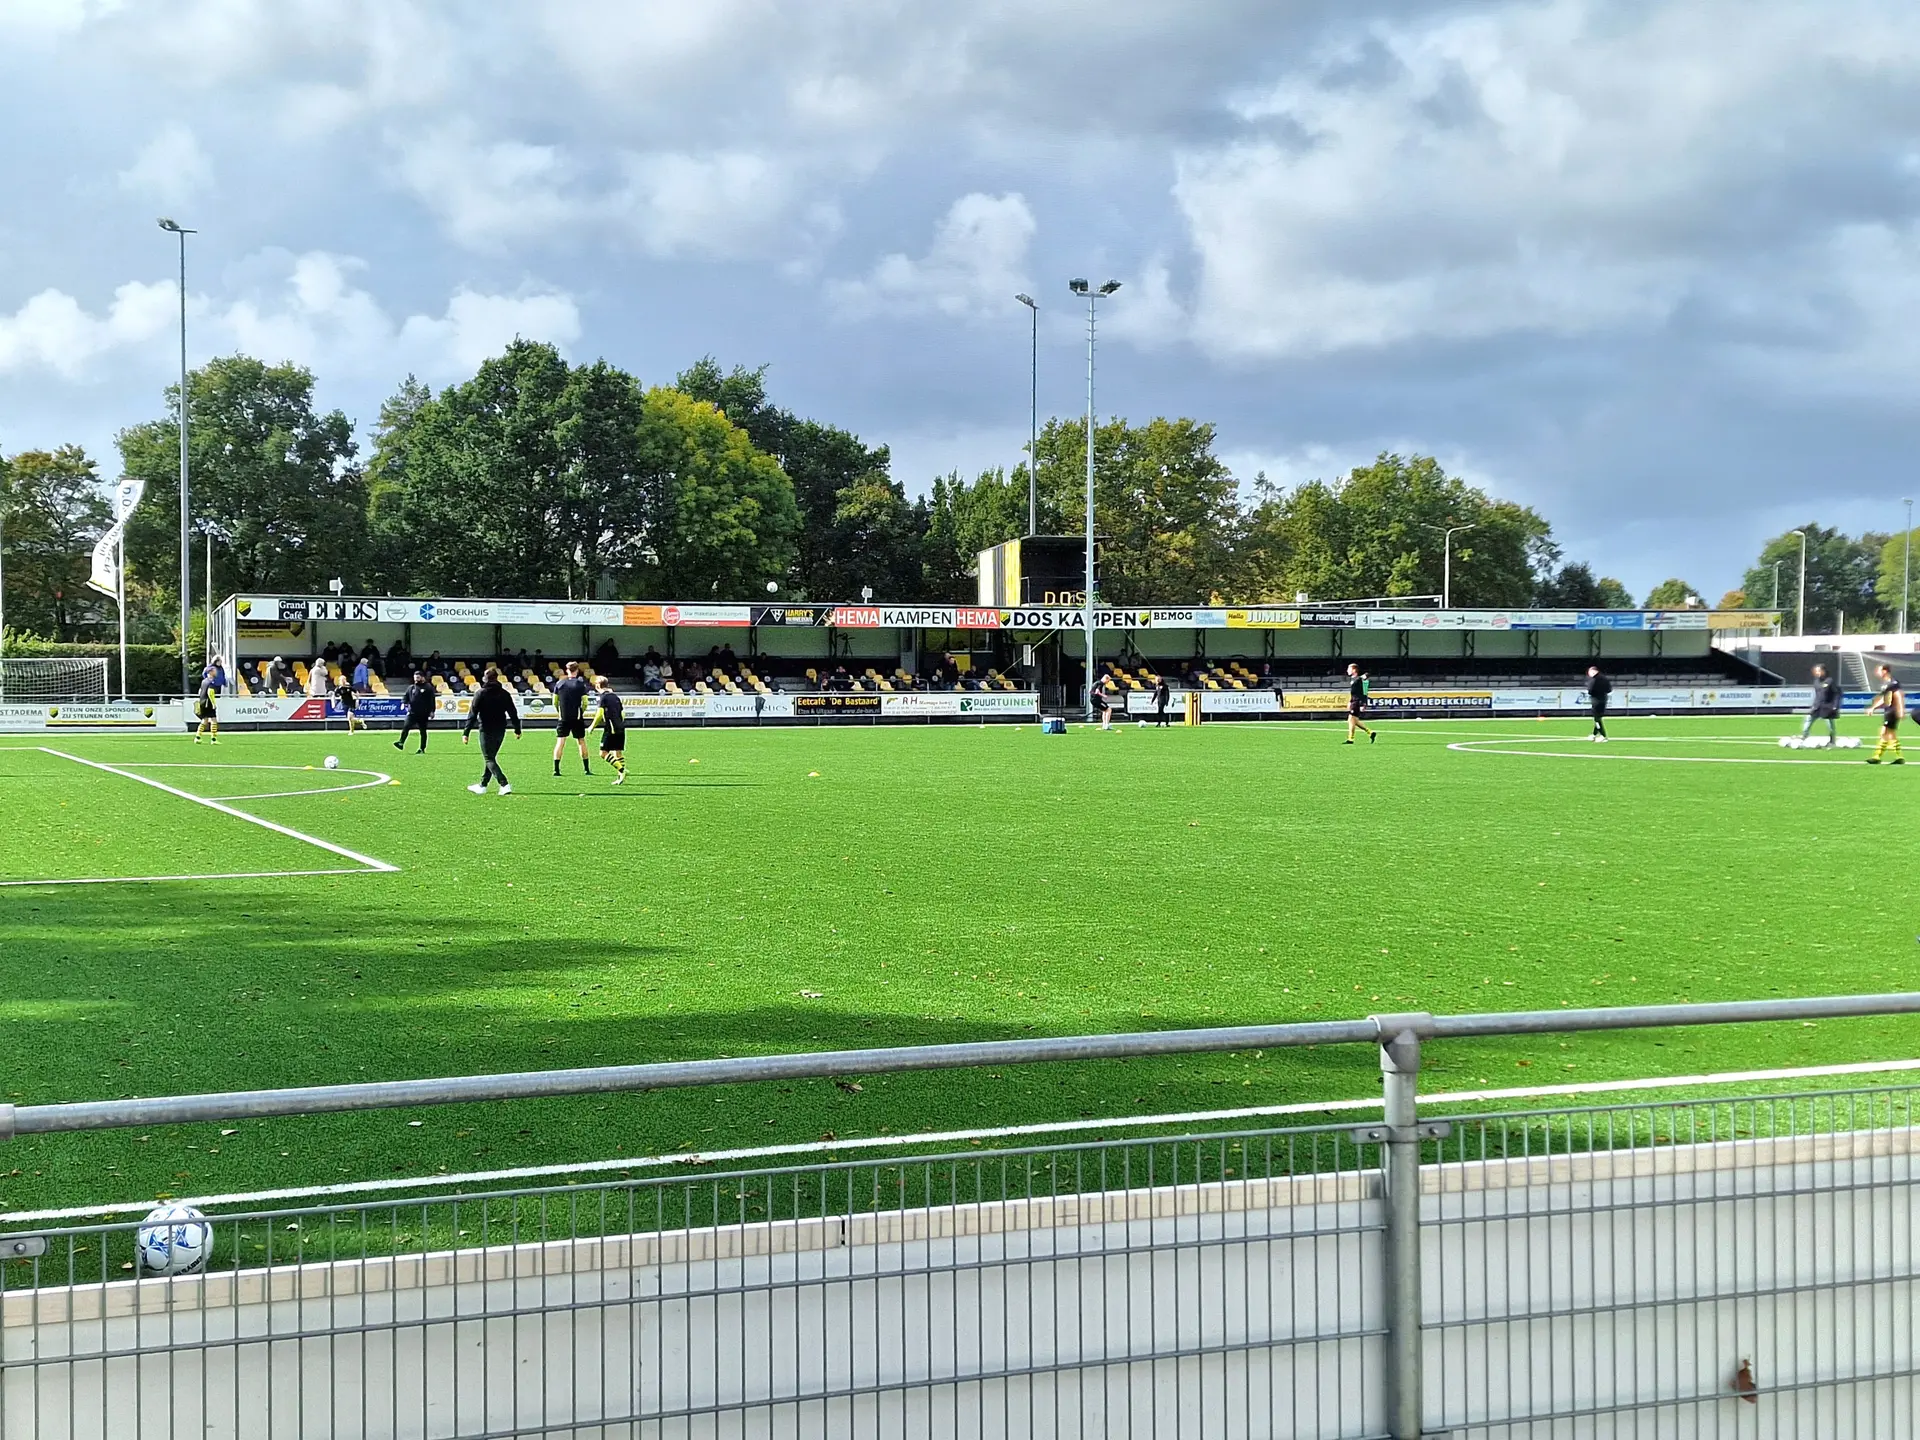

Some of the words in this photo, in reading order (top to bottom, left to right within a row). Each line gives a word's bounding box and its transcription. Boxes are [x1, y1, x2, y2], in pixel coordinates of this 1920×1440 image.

[279, 600, 306, 610] Grand
[282, 610, 303, 620] Café
[308, 601, 378, 620] EFES
[437, 608, 489, 616] BROEKHUIS
[785, 609, 814, 617] HARRY'S
[836, 610, 879, 625] HEMA
[884, 611, 952, 625] KAMPEN
[956, 611, 997, 625] HEMA
[1013, 612, 1053, 627] DOS
[1153, 612, 1193, 620] BEMOG
[1247, 611, 1298, 624] JUMBO
[1578, 611, 1613, 625] Primo
[659, 698, 690, 706] KAMPEN
[797, 697, 826, 706] Eetcafé
[974, 698, 1034, 706] PUURTUINEN
[1367, 698, 1400, 706] LFSMA
[1402, 698, 1491, 706] DAKBEDEKKINGEN
[235, 707, 268, 715] HABOVO
